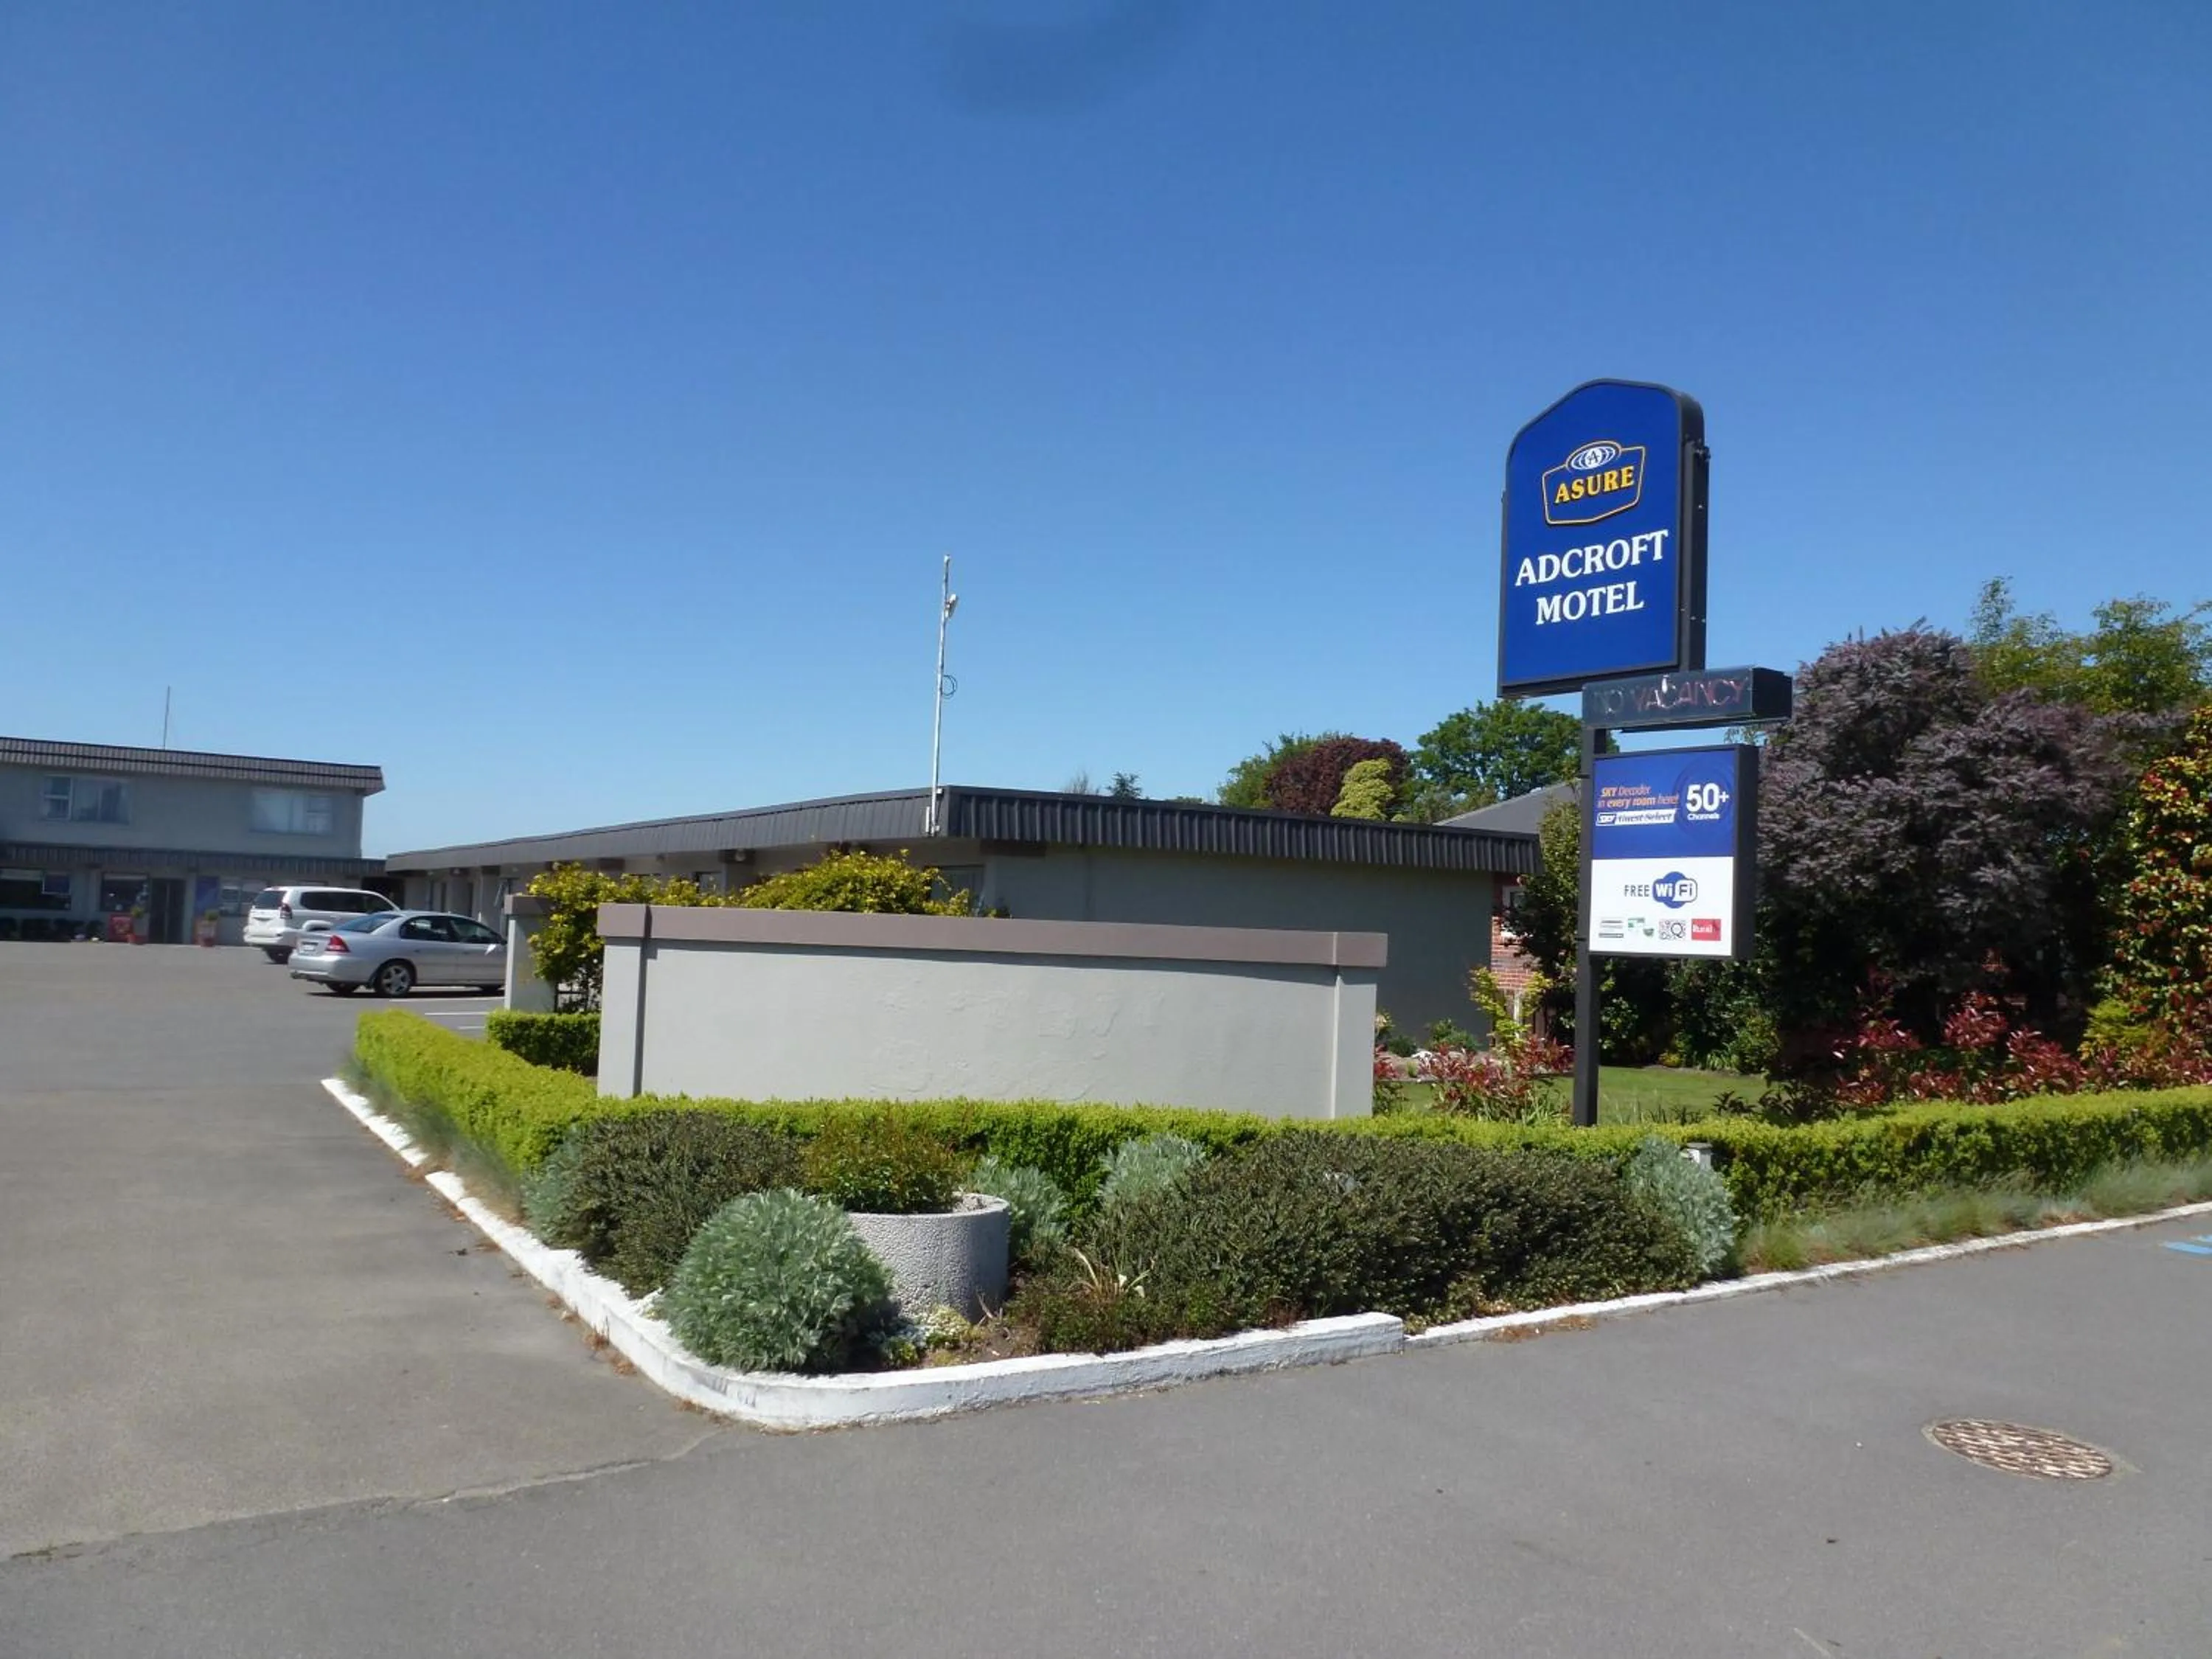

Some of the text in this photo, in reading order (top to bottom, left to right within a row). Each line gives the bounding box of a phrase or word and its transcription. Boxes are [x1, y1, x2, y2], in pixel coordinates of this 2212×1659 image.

[1554, 465, 1635, 504] ASURE
[1514, 529, 1669, 587] ADCROFT
[1535, 581, 1644, 625] MOTEL
[1630, 677, 1748, 712] VACANCY
[1607, 798, 1631, 810] every
[1632, 796, 1656, 806] room
[1686, 782, 1730, 812] 50+
[1624, 883, 1650, 897] FREE
